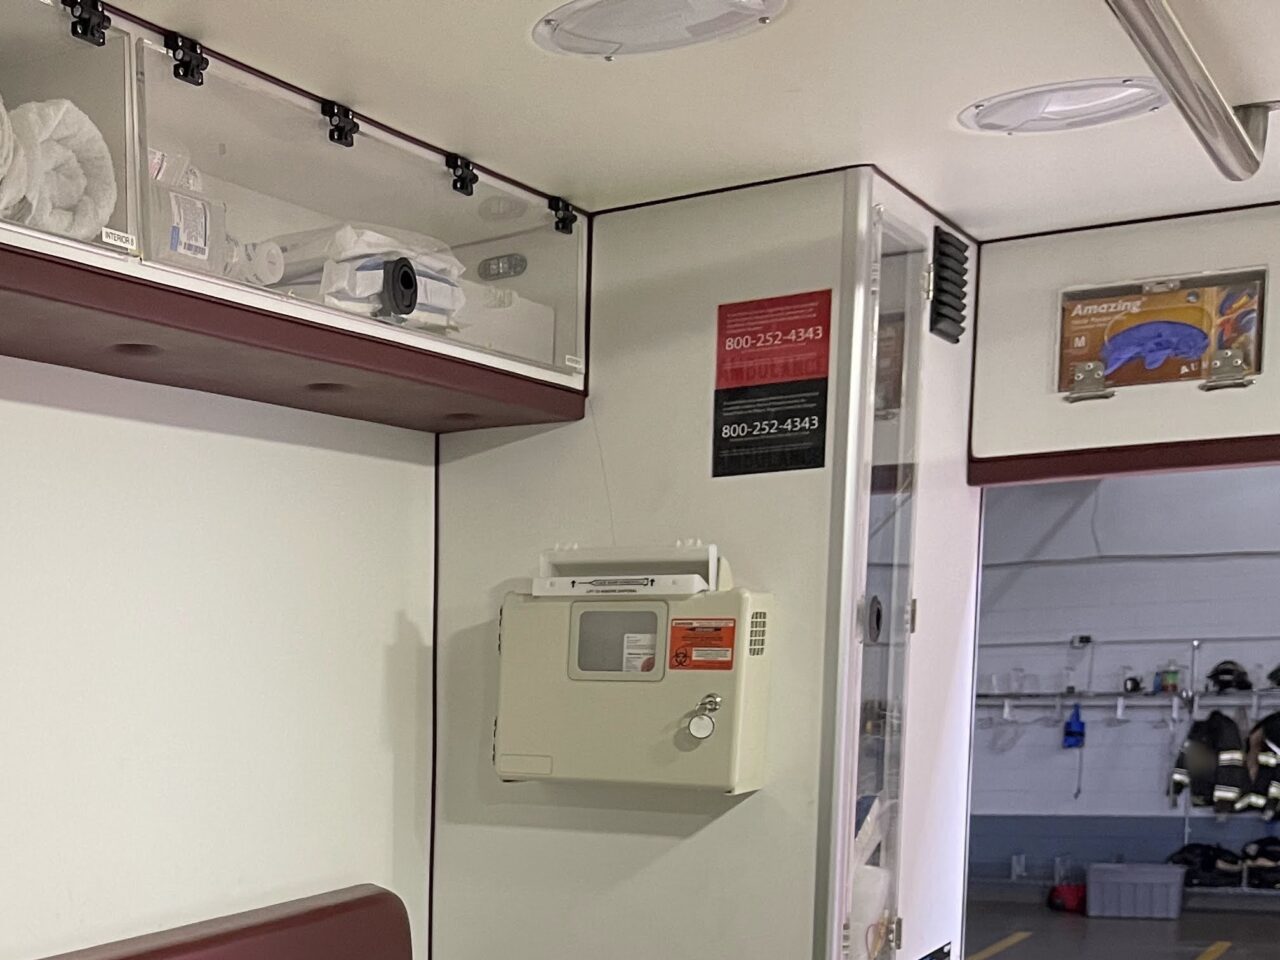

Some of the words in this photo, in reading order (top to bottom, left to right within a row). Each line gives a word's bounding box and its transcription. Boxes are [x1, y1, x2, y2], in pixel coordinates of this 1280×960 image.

[1071, 300, 1142, 317] Amazing
[725, 326, 823, 351] 800-252-4343
[1073, 335, 1086, 348] M
[721, 415, 819, 438] 800-252-4343
